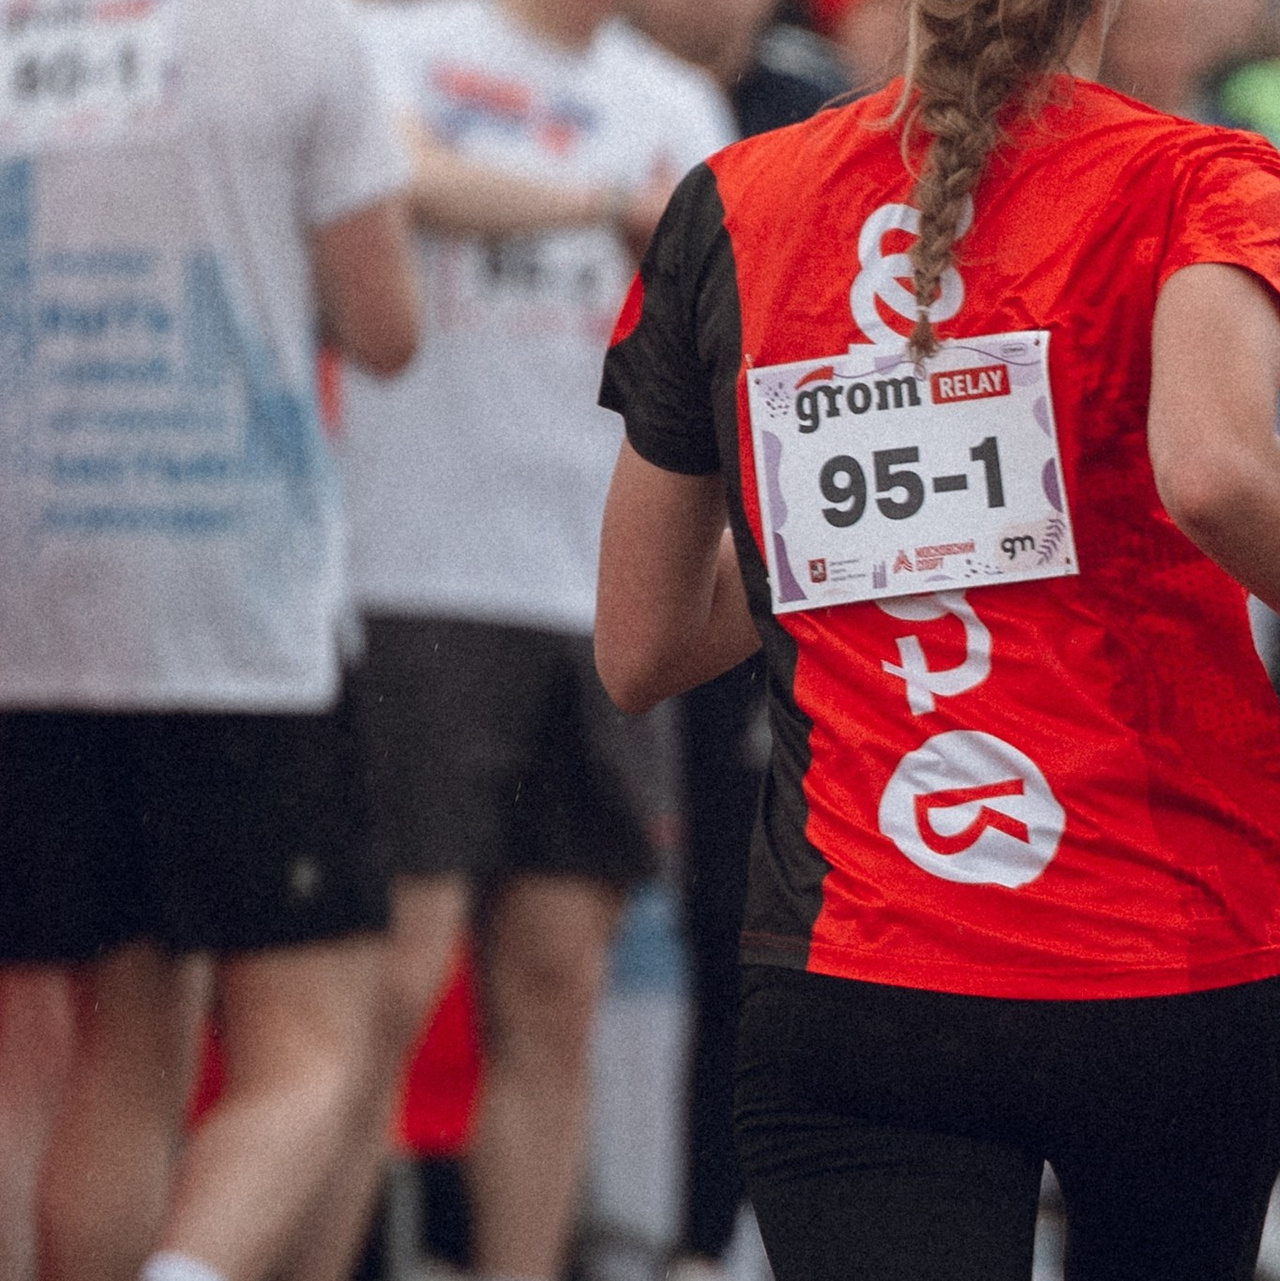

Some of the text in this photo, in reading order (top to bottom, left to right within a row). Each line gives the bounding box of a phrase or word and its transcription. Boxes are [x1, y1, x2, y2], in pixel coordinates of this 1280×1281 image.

[795, 370, 1004, 434] grom RELAY
[818, 435, 1006, 528] 95-1
